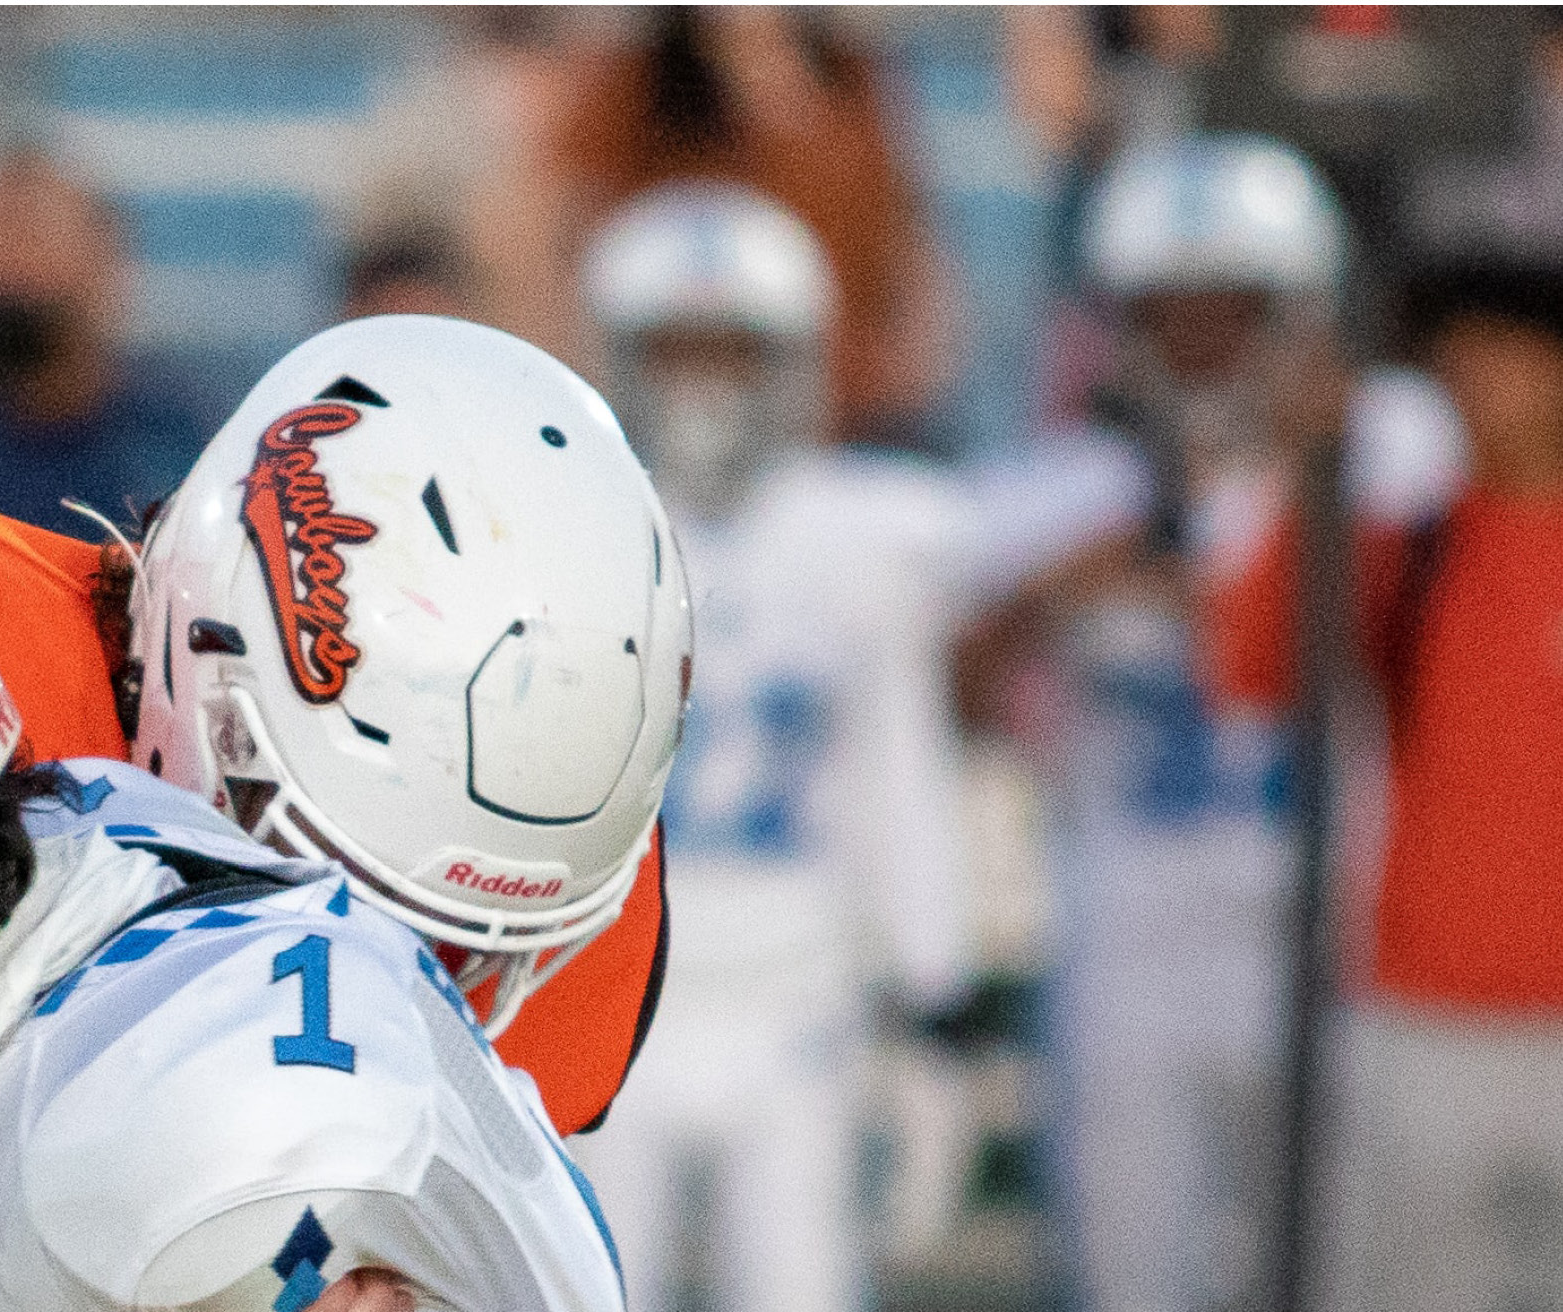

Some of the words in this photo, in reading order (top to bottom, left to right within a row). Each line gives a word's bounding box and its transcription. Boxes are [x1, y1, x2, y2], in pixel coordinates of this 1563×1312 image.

[238, 402, 380, 706] Cowboys
[444, 861, 564, 898] Riddell
[271, 932, 356, 1076] 1
